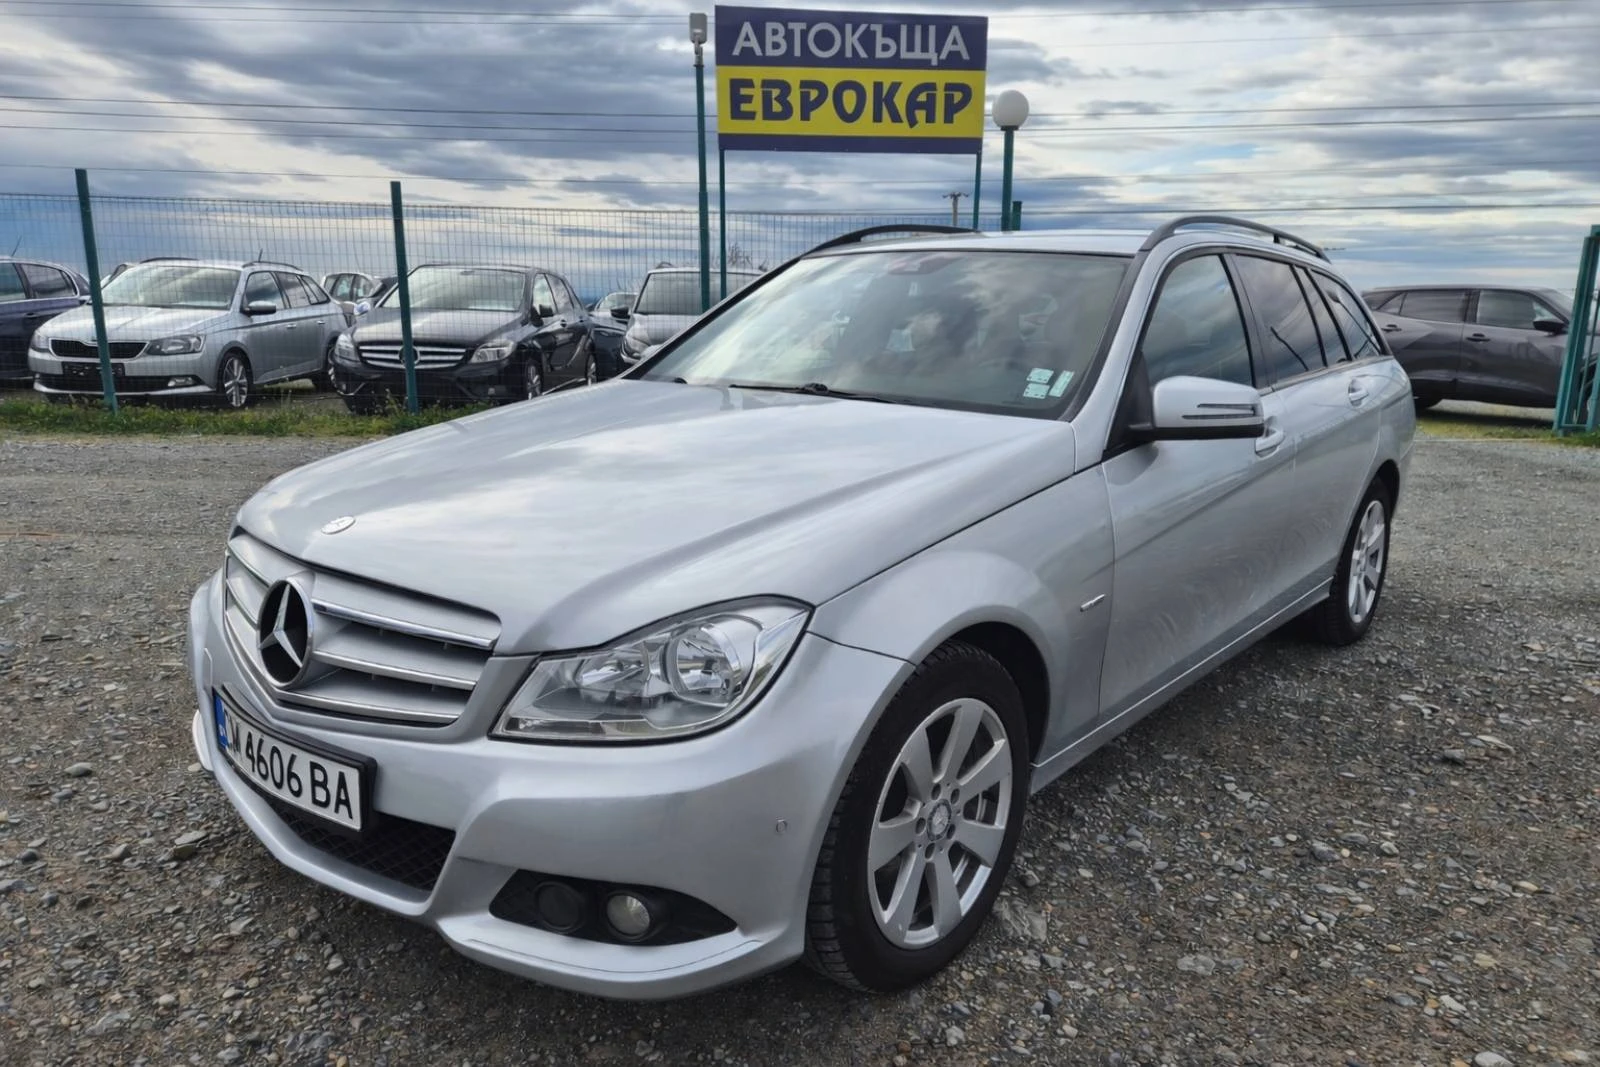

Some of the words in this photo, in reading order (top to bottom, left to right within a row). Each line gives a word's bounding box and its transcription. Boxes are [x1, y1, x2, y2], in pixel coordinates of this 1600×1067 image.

[732, 21, 970, 66] АВТОКЪЩА
[729, 78, 972, 128] ЕВРОКАР
[245, 731, 303, 798] 4606
[309, 760, 353, 820] BA
